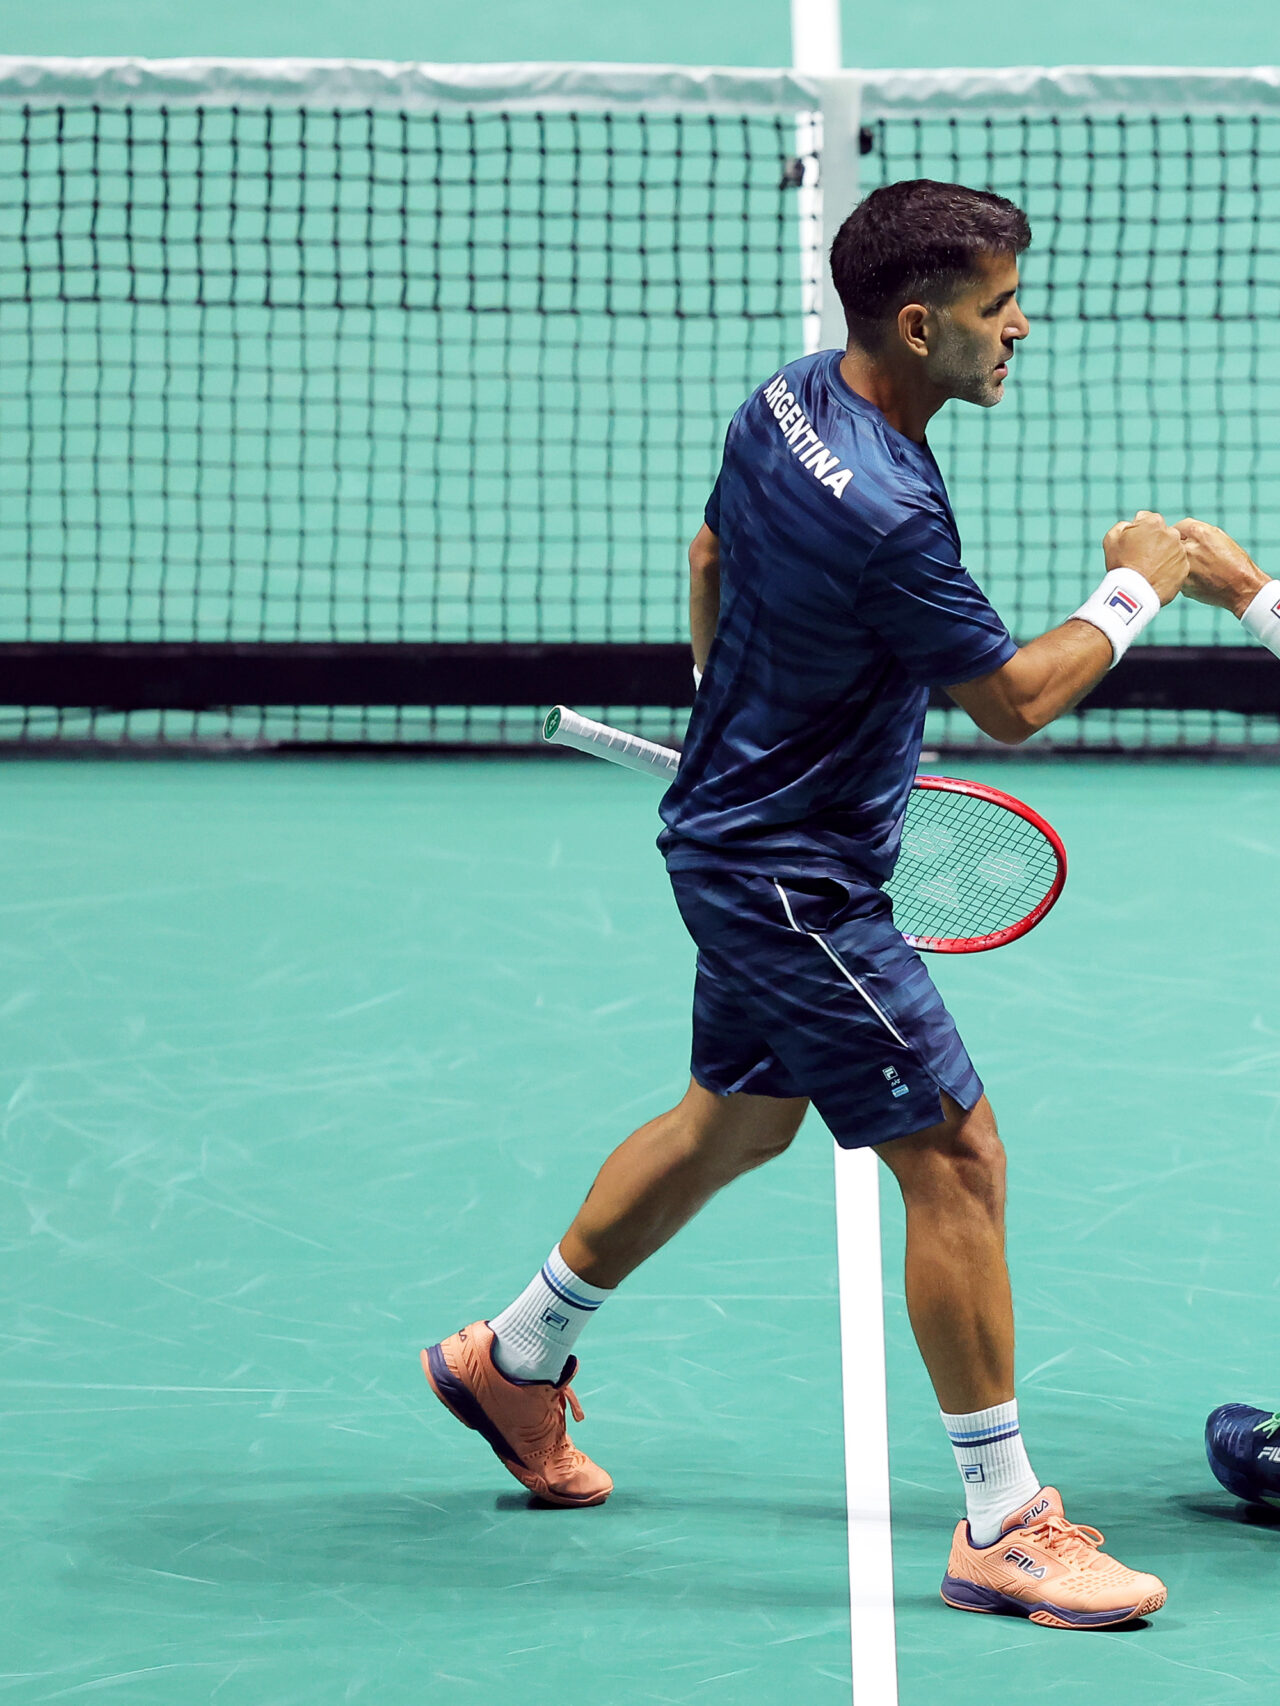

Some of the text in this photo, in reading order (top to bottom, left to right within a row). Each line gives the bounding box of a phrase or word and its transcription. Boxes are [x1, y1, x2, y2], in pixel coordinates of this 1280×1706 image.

[763, 374, 853, 499] ARGENTINA
[1021, 1499, 1050, 1525] FILA
[1003, 1547, 1047, 1580] FILA
